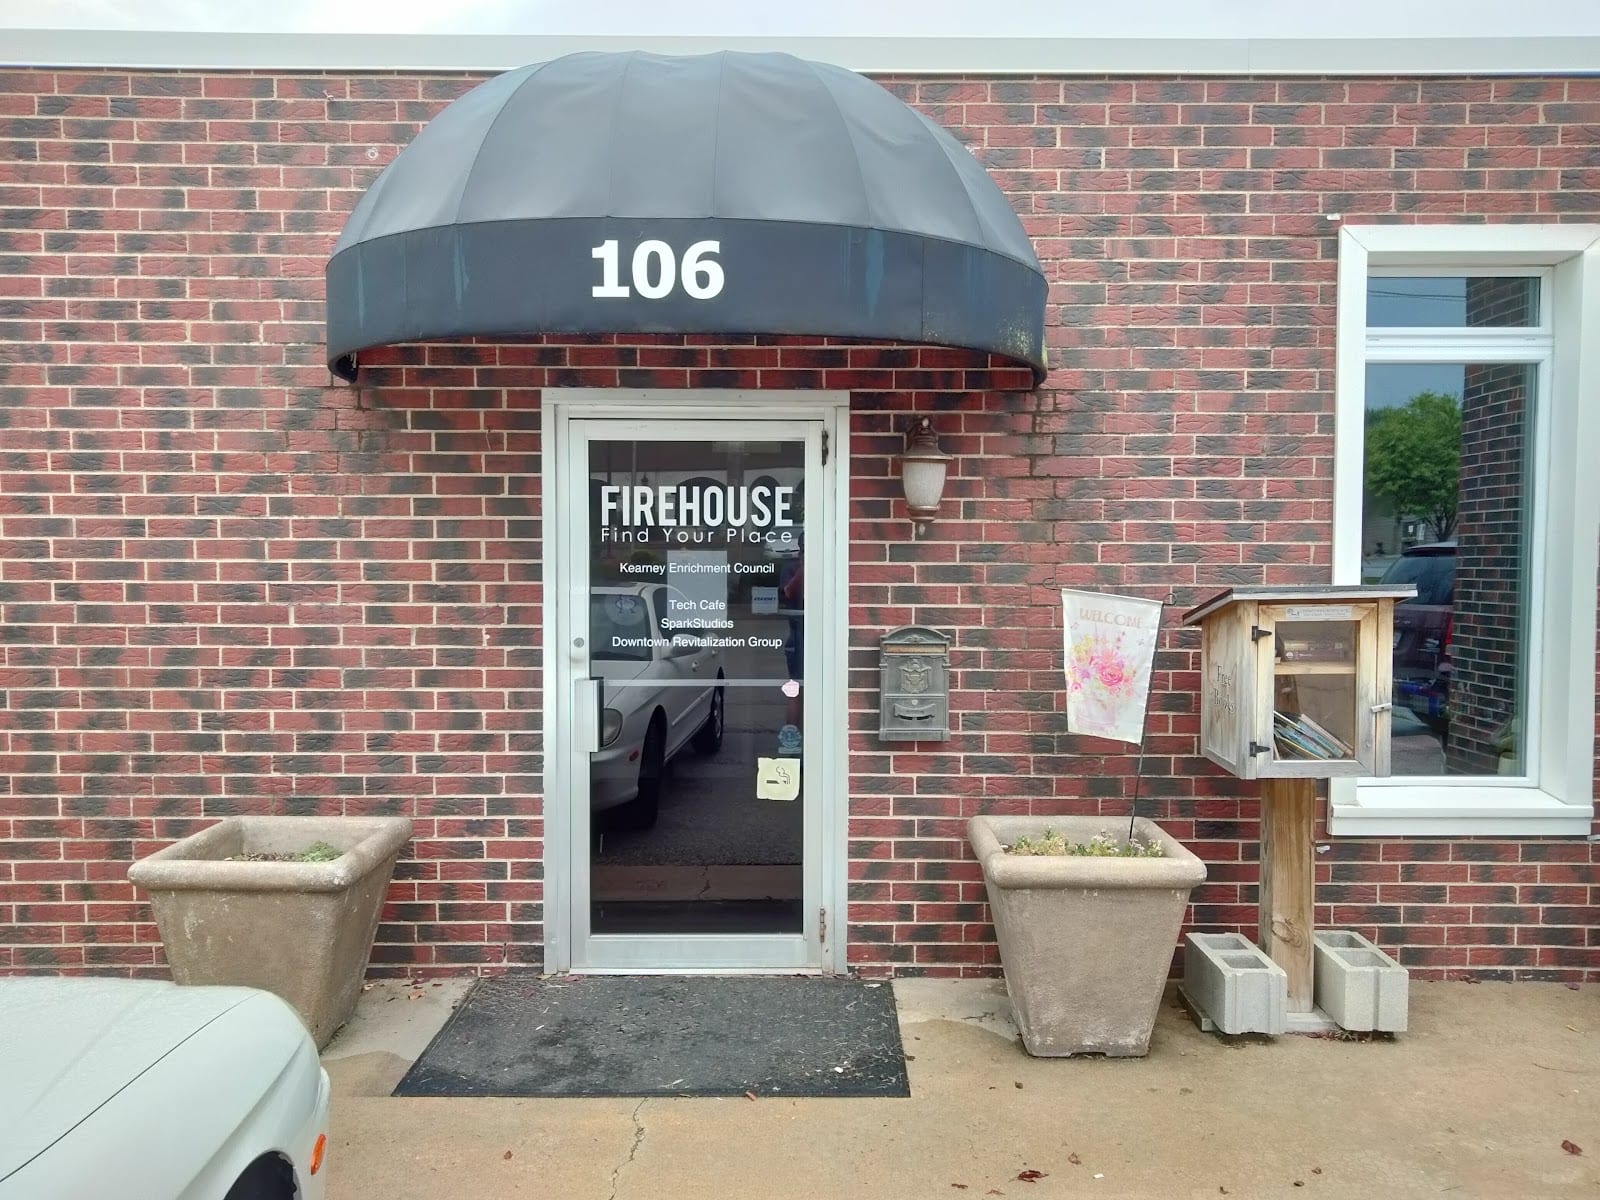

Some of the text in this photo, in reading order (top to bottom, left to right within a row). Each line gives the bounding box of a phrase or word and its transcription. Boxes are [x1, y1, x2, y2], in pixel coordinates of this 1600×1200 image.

[592, 239, 725, 300] 106
[601, 486, 793, 527] FIREHOUSE
[601, 528, 793, 543] Find Your Place
[619, 563, 775, 576] Kearney Enrichment Council
[669, 600, 726, 611] Tech Cafe
[661, 618, 734, 630] SparkStudios
[1080, 607, 1145, 629] WELCOME
[612, 636, 783, 649] Downtown Revitalization Group
